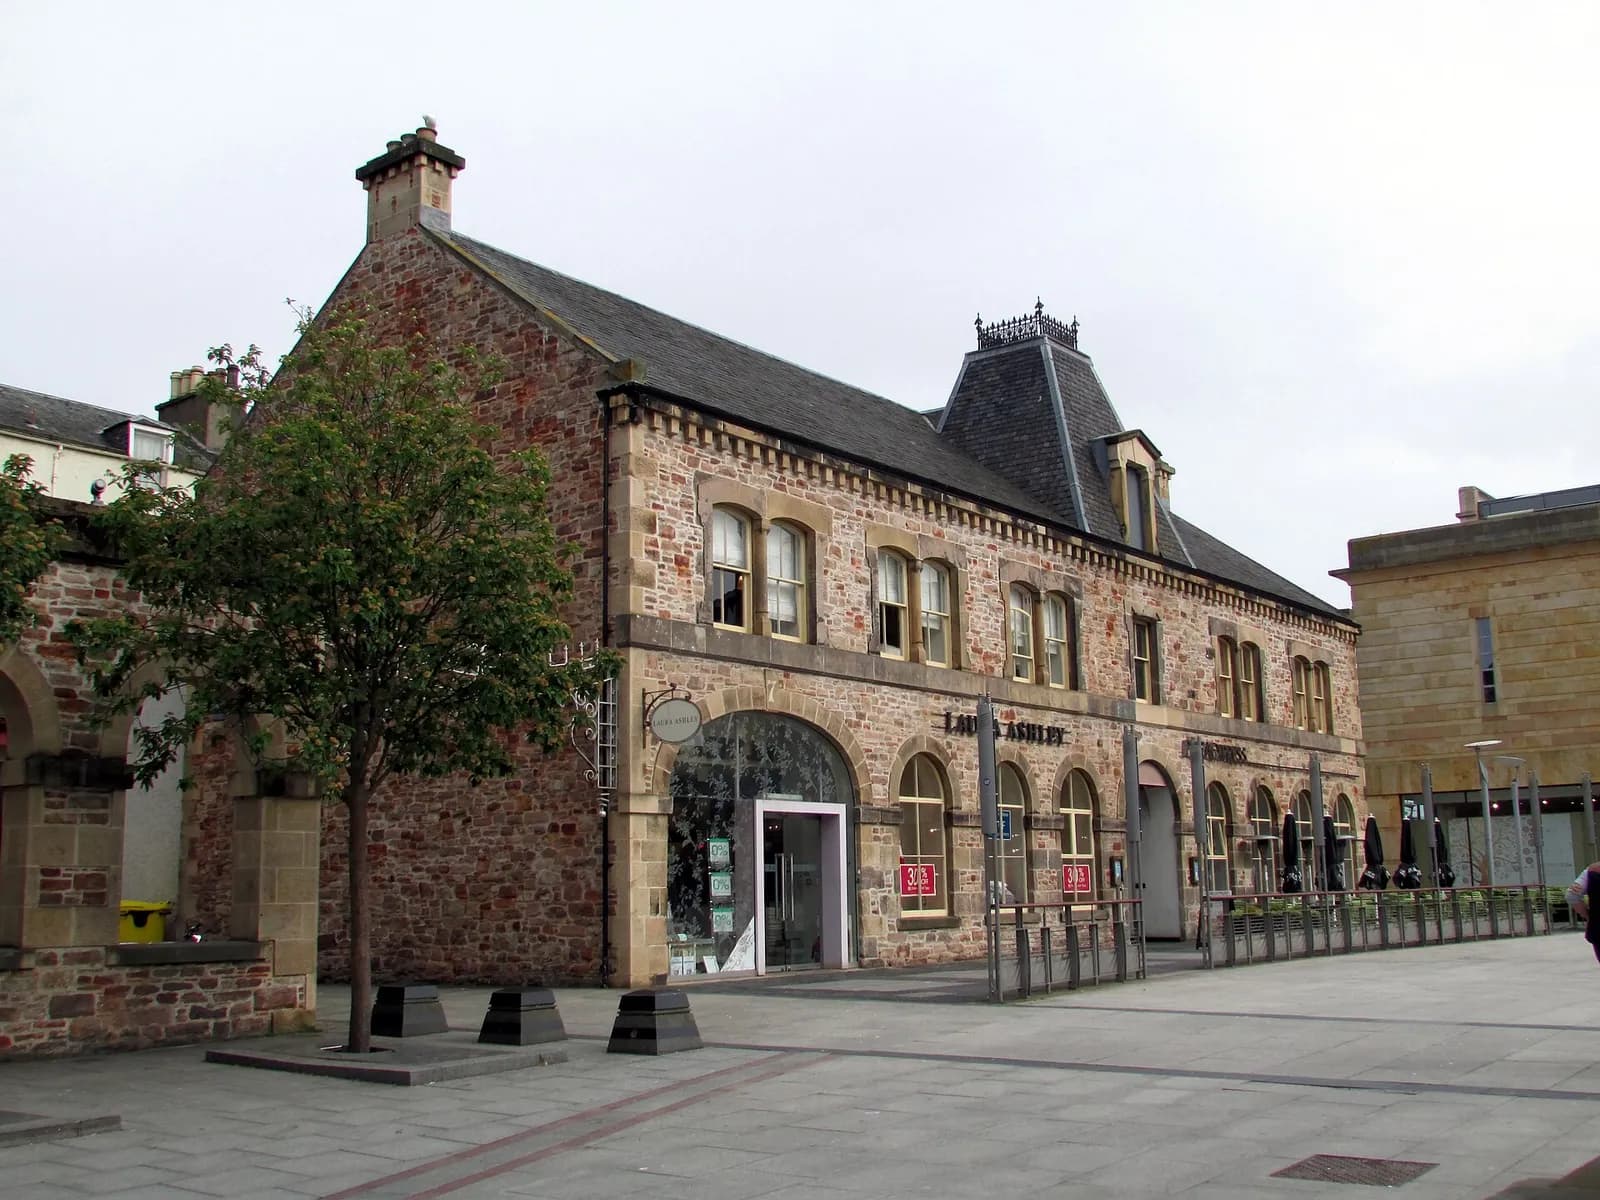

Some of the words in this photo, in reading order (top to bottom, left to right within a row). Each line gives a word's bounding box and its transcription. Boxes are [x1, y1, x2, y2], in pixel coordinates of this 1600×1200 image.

[653, 718, 673, 727] LAURA
[675, 715, 698, 725] ASHLEY
[944, 711, 1001, 739] LAUA
[1006, 720, 1065, 747] ASHLEY
[711, 844, 729, 857] 0%
[712, 878, 730, 891] 0%
